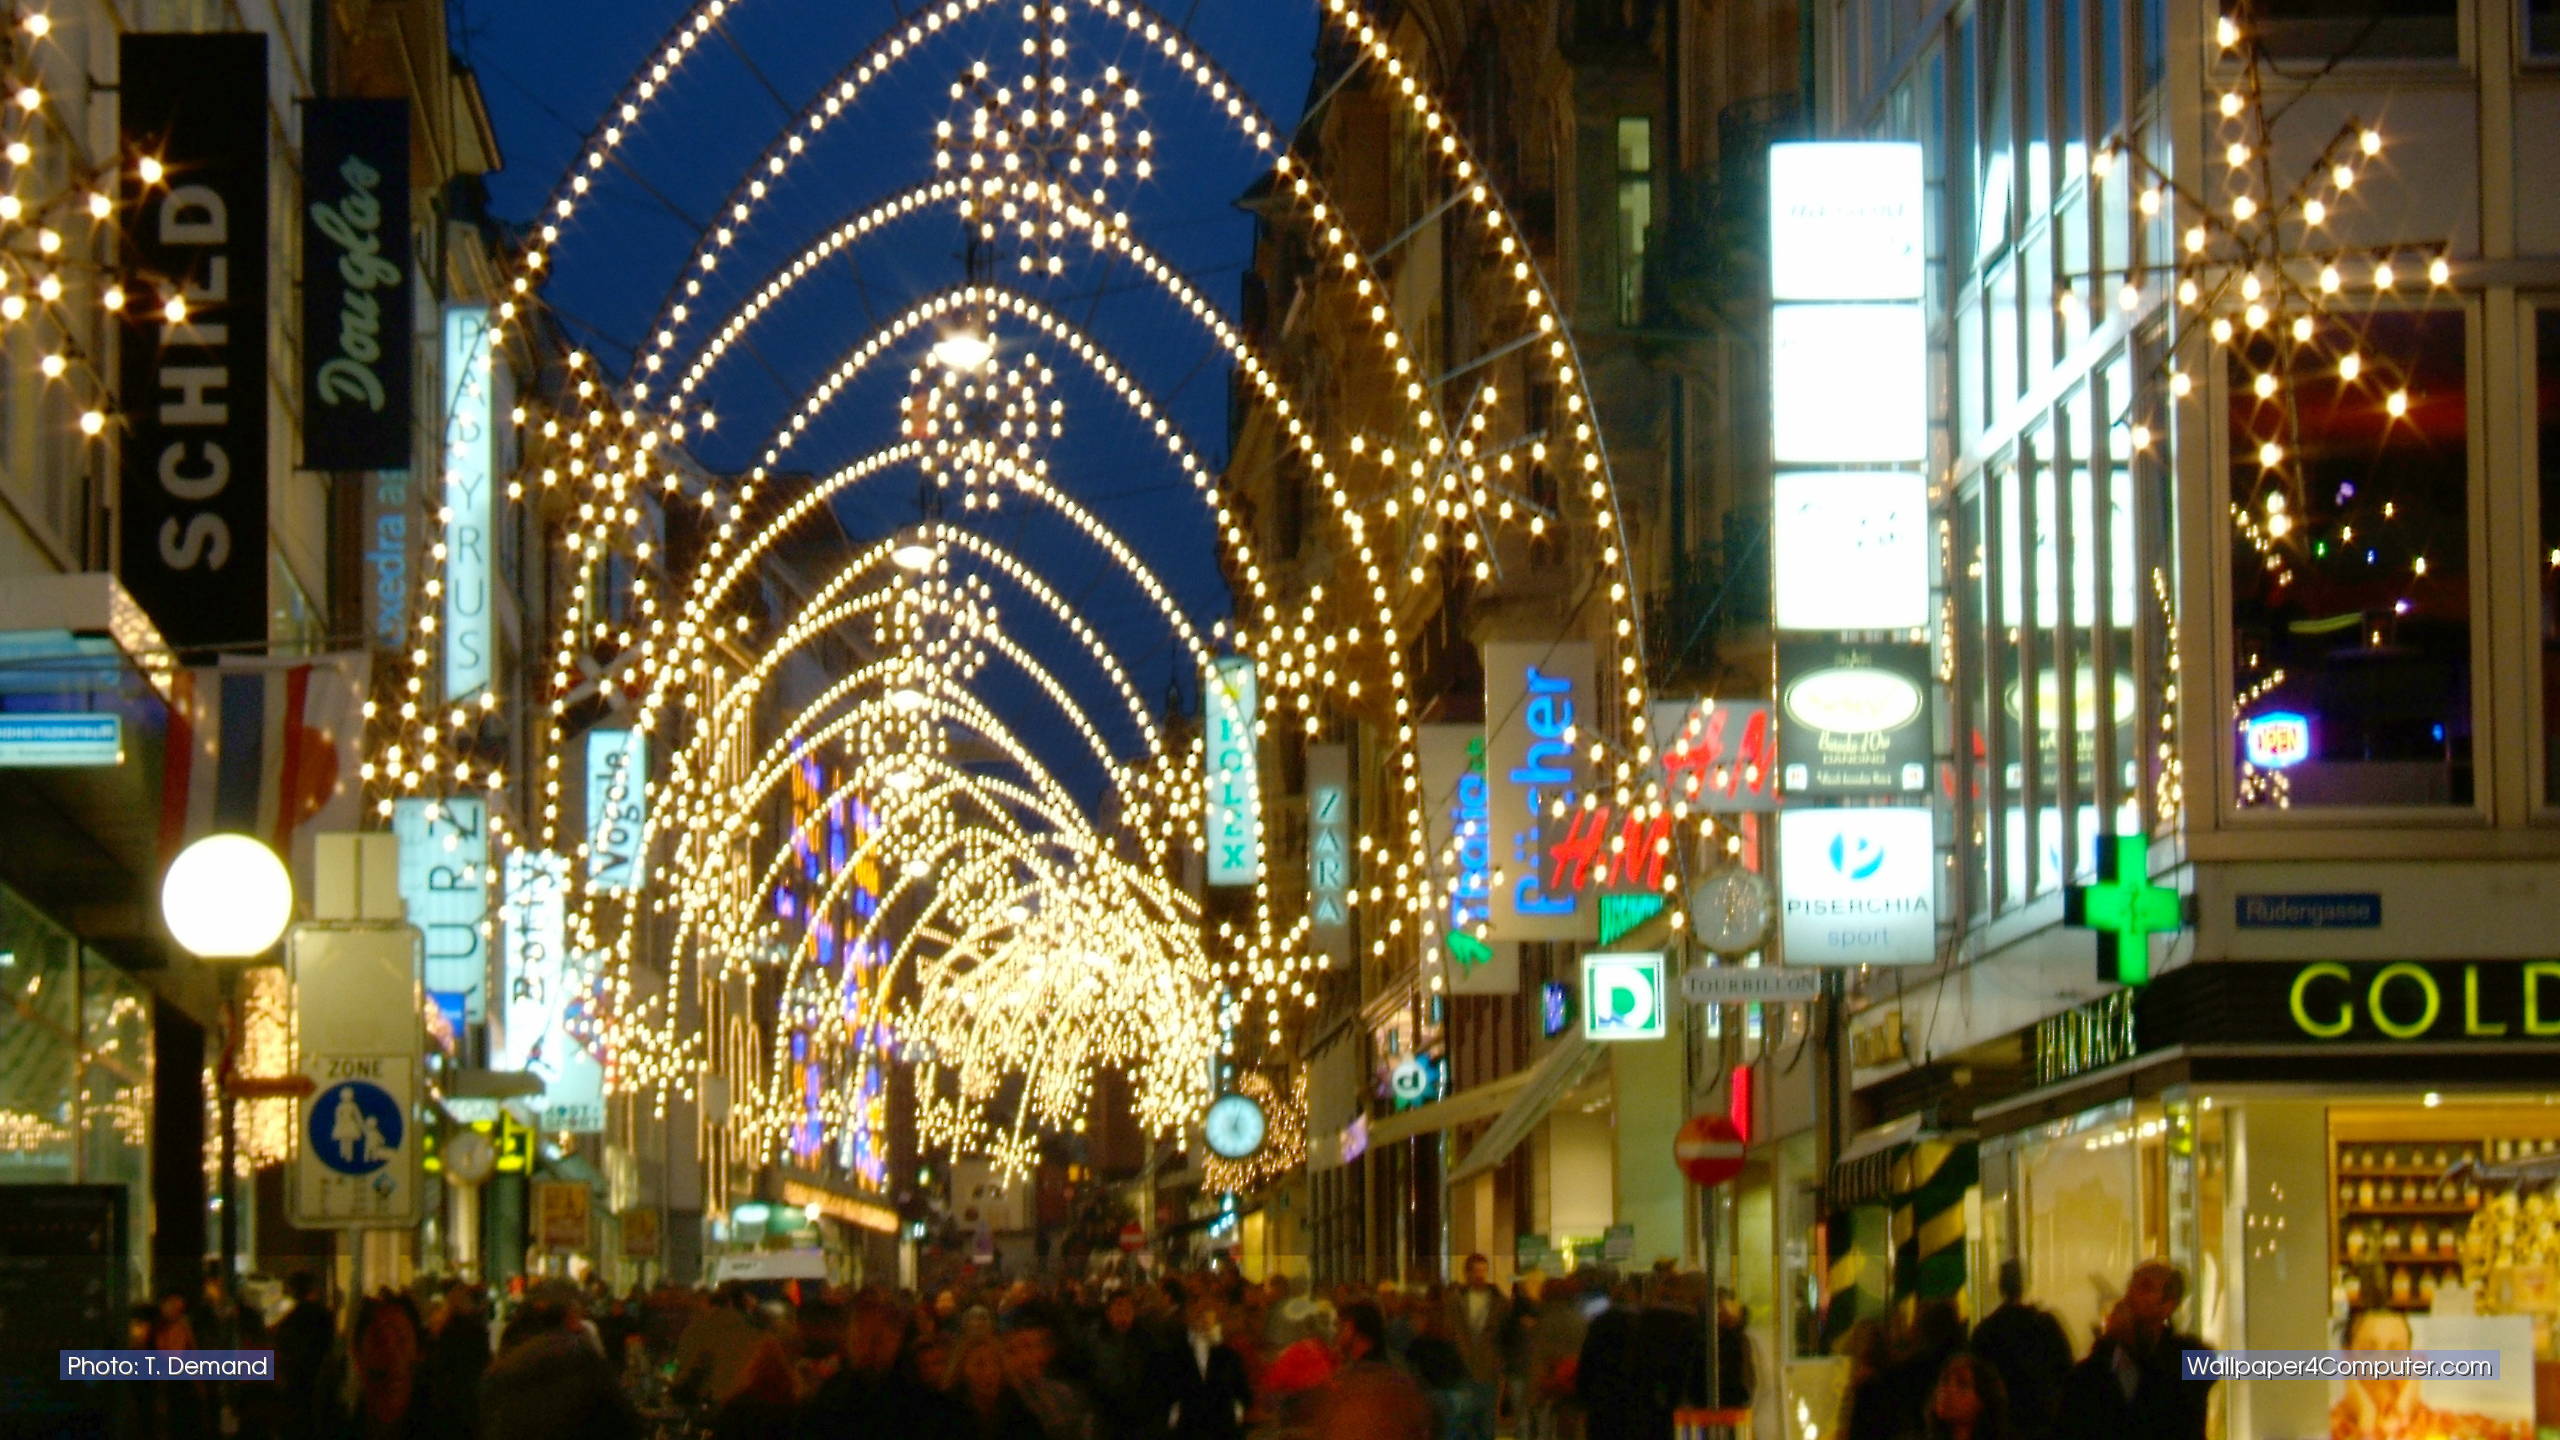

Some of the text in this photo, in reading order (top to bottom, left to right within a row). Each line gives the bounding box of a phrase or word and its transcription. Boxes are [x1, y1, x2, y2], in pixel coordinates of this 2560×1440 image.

[311, 155, 402, 412] Douglas
[159, 184, 231, 572] SCHILD
[454, 316, 486, 669] PAPYRUS
[1663, 710, 1783, 803] HM
[1319, 792, 1341, 922] ZARA
[1550, 806, 1672, 891] HM
[1787, 896, 1929, 916] PISERCHIA
[1828, 927, 1889, 953] sport
[2290, 962, 2560, 1039] GOLD
[328, 1060, 384, 1078] ZONE
